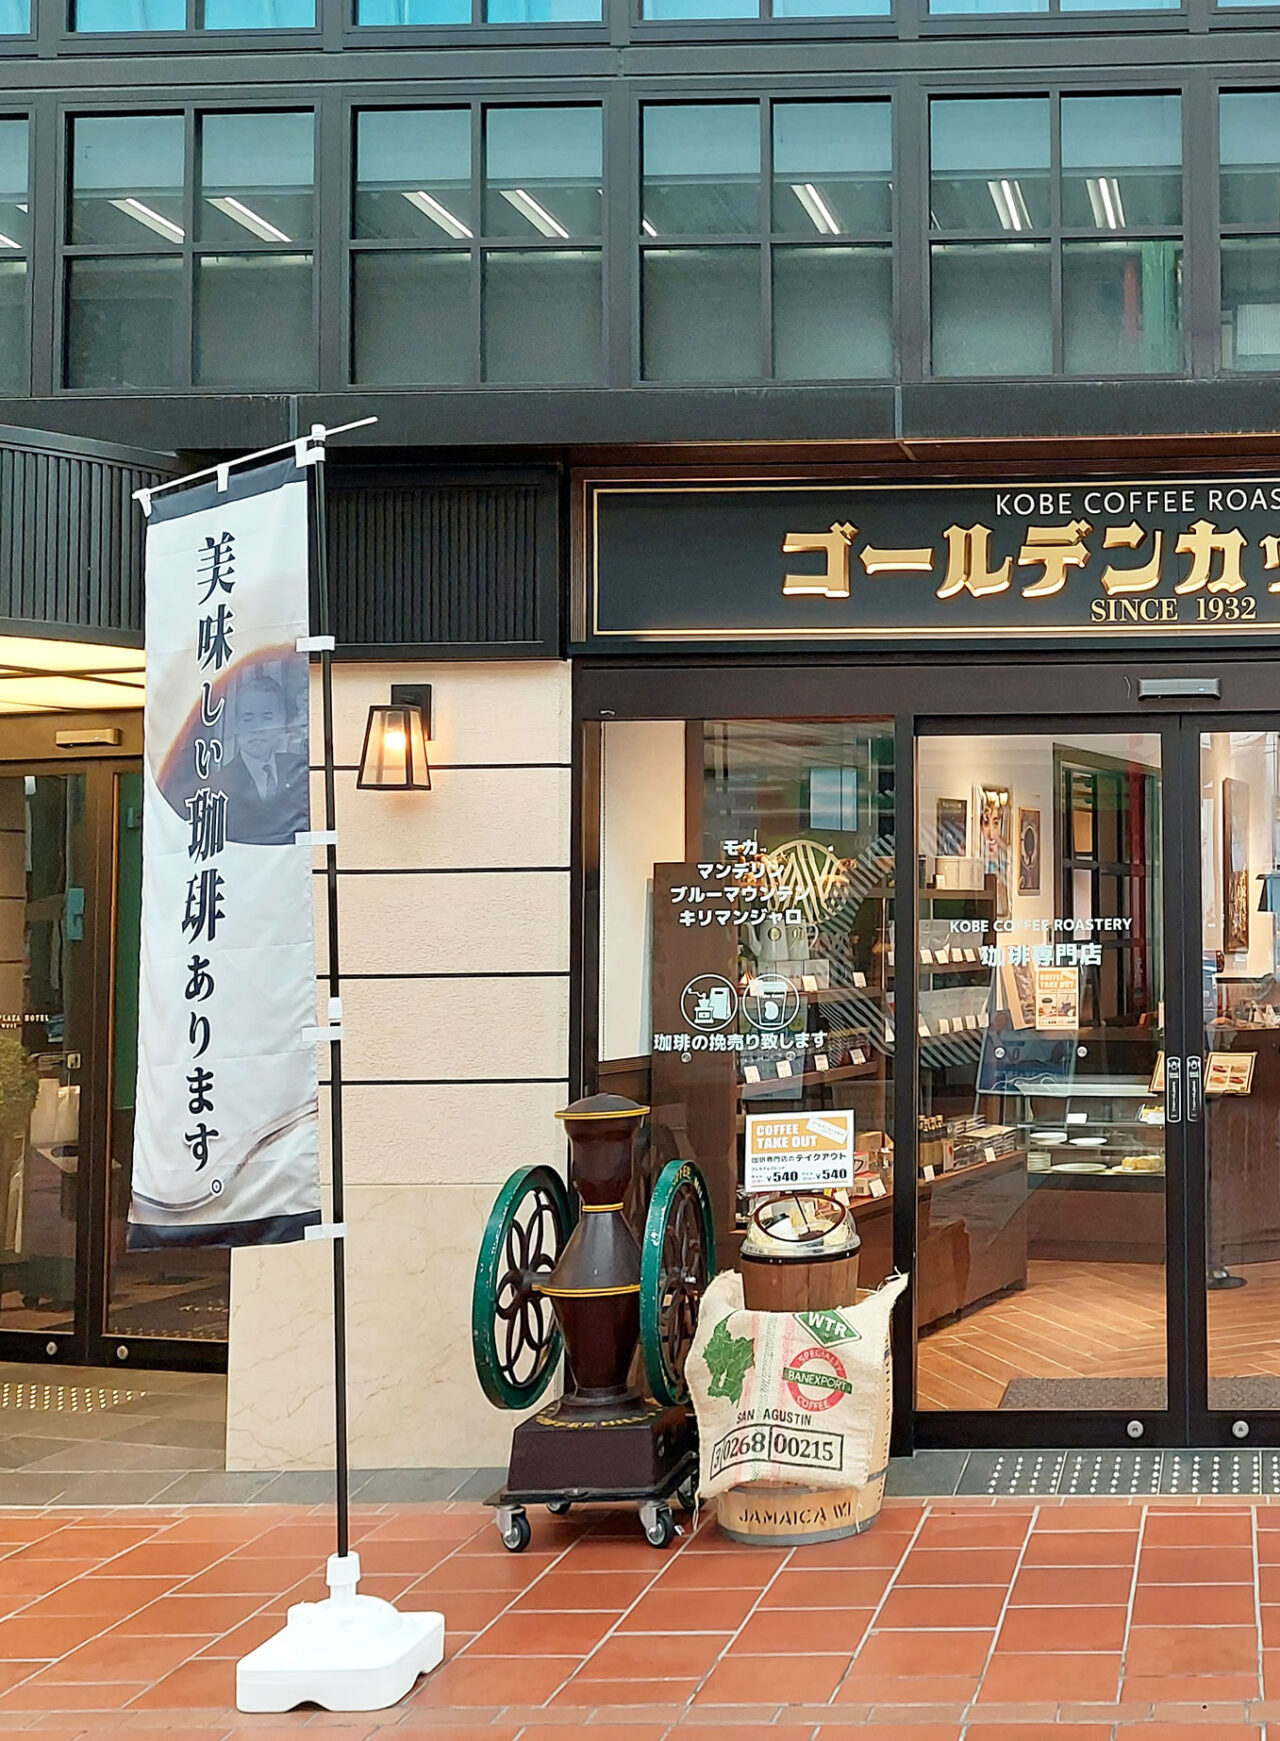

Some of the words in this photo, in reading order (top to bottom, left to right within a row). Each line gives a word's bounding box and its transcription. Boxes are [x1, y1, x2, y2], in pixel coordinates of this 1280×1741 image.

[996, 493, 1072, 516] KOBE
[1084, 490, 1195, 514] COFFEE
[1091, 598, 1178, 622] SINCE
[1196, 596, 1257, 621] 1932
[723, 839, 758, 857] モカ
[183, 530, 236, 1194] 美味しい珈琲あります。
[697, 862, 785, 880] マンデリン
[670, 886, 810, 904] ブルーマウンテン
[679, 908, 802, 927] キリマンジャロ
[950, 919, 989, 933] KOBE
[993, 918, 1050, 933] COFFEE
[1054, 917, 1133, 932] ROASTERY
[981, 942, 1103, 967] 珈琲専門店
[24, 1014, 49, 1022] HOTEL
[653, 1030, 828, 1052] 珈琲の挽売り致します
[756, 1123, 800, 1137] COFFEE
[756, 1136, 789, 1150] TAKE
[791, 1135, 819, 1149] OUT
[807, 1311, 848, 1339] WTR
[788, 1370, 847, 1391] BANEXPORT
[797, 1395, 829, 1410] COFFEE
[736, 1409, 755, 1425] SAN
[763, 1409, 812, 1426] AGUSTIN
[739, 1506, 827, 1526] JAMAICA
